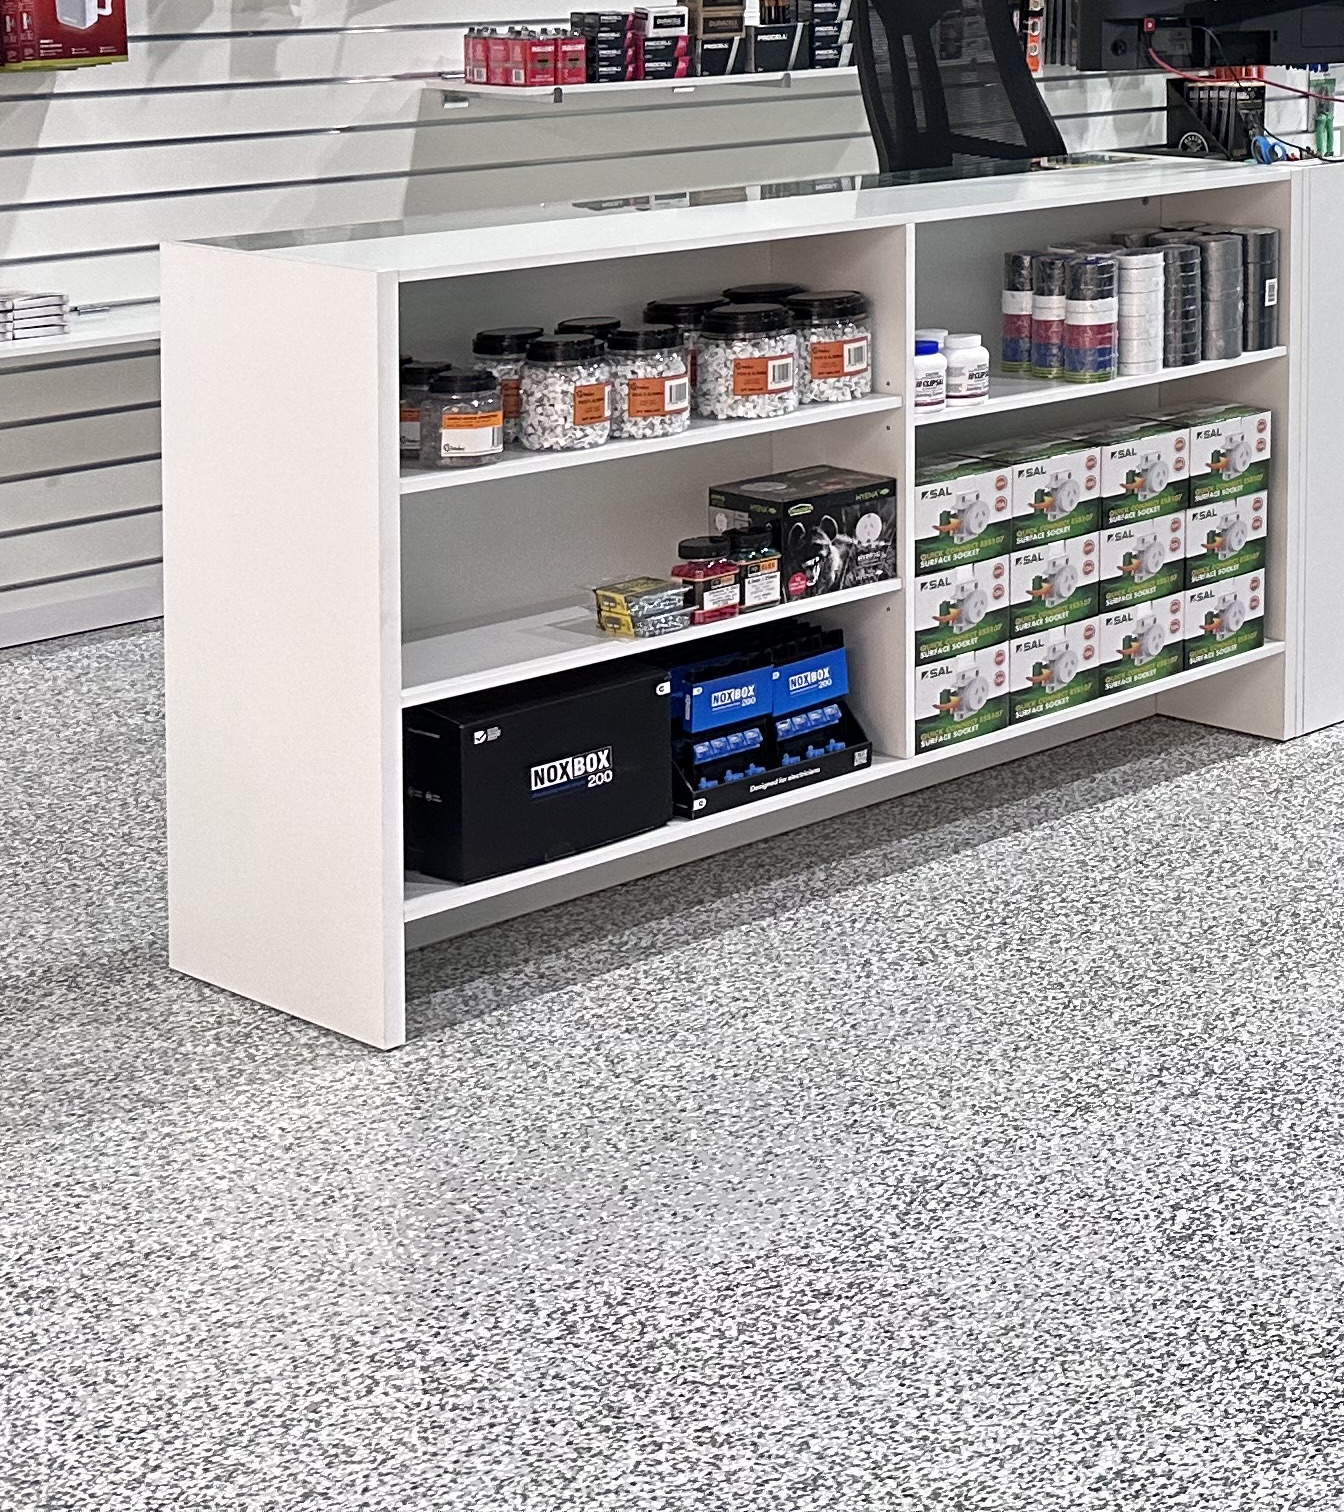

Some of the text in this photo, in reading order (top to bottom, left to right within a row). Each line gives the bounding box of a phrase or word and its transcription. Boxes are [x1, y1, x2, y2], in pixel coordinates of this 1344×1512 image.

[1203, 428, 1222, 439] SAL
[1117, 448, 1137, 459] SAL
[1026, 466, 1046, 477] SAL
[929, 486, 952, 500] SAL
[1199, 509, 1217, 520] SAL
[1114, 530, 1134, 541] SAL
[1023, 553, 1044, 565] SAL
[929, 578, 952, 591] SAL
[1197, 590, 1215, 602] SAL
[1113, 613, 1133, 626] SAL
[1023, 640, 1044, 651] SAL
[929, 666, 952, 678] SAL
[587, 770, 613, 788] 200
[750, 776, 778, 793] Designed
